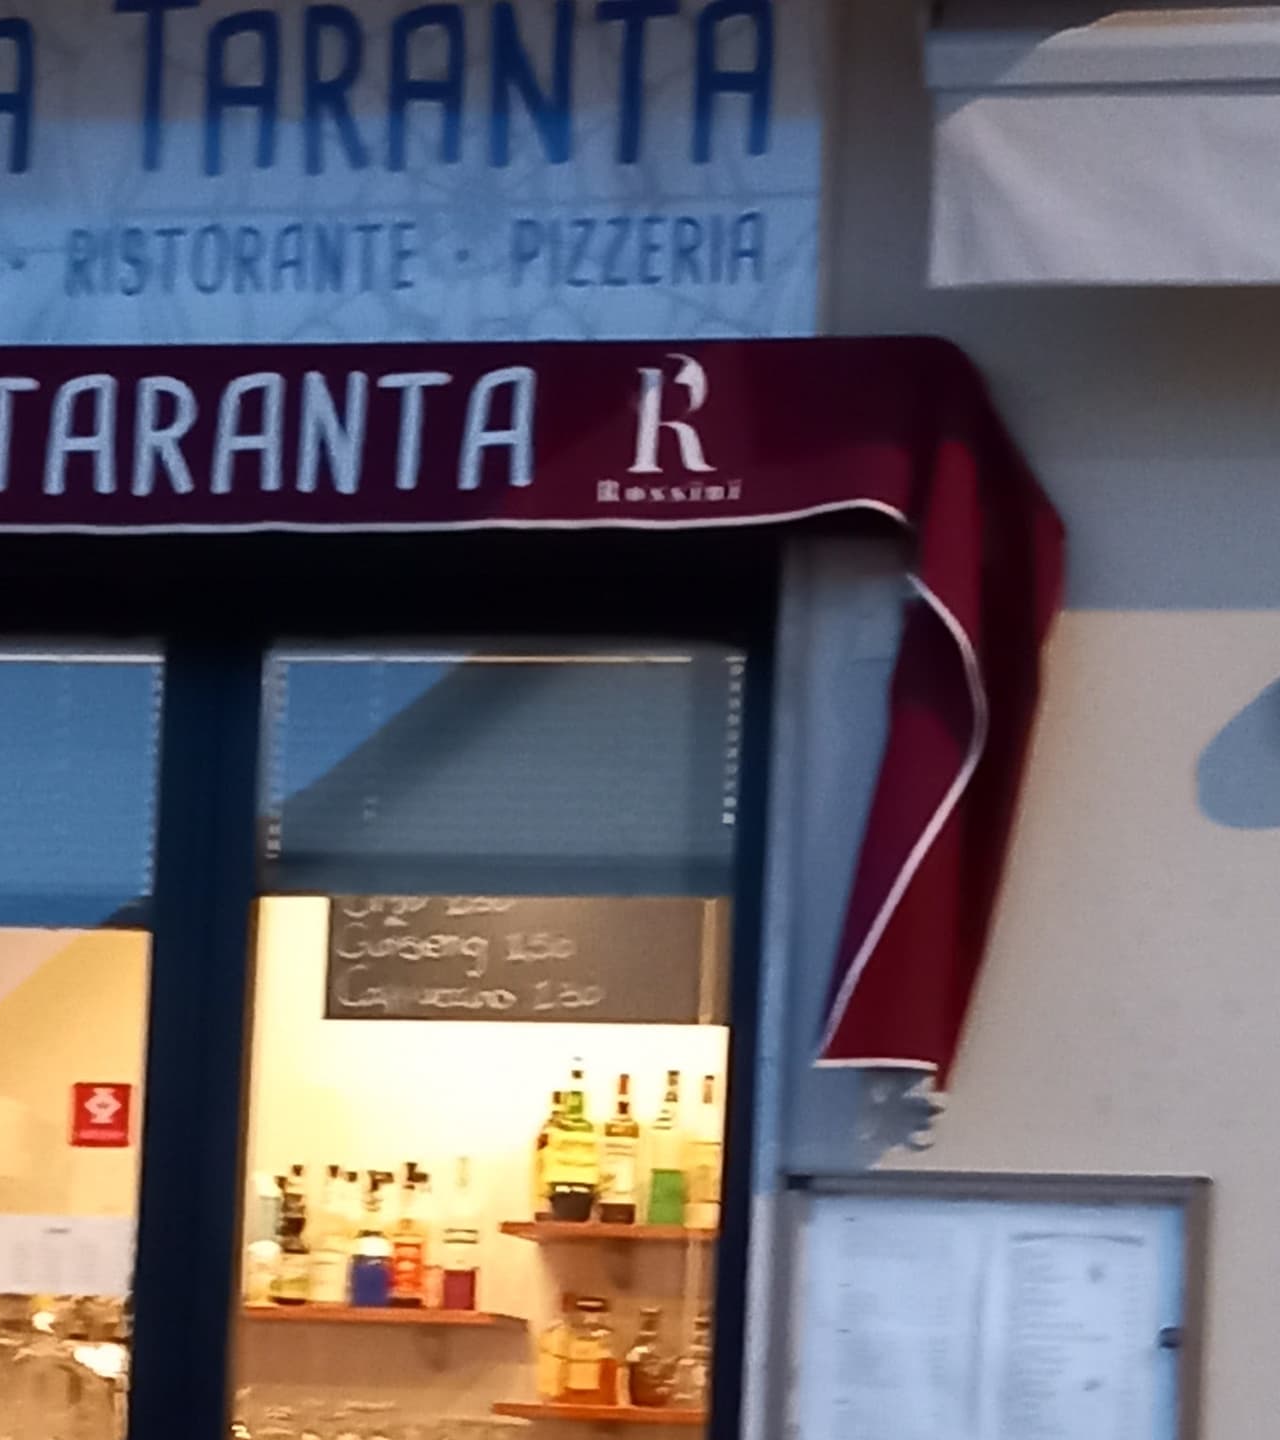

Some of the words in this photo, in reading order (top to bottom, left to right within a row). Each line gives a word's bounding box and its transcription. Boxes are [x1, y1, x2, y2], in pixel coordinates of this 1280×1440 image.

[114, 0, 774, 176] TARANTA
[65, 219, 421, 296] RISTORANTE
[510, 210, 766, 289] PIZZERIA
[596, 478, 742, 502] Rossini
